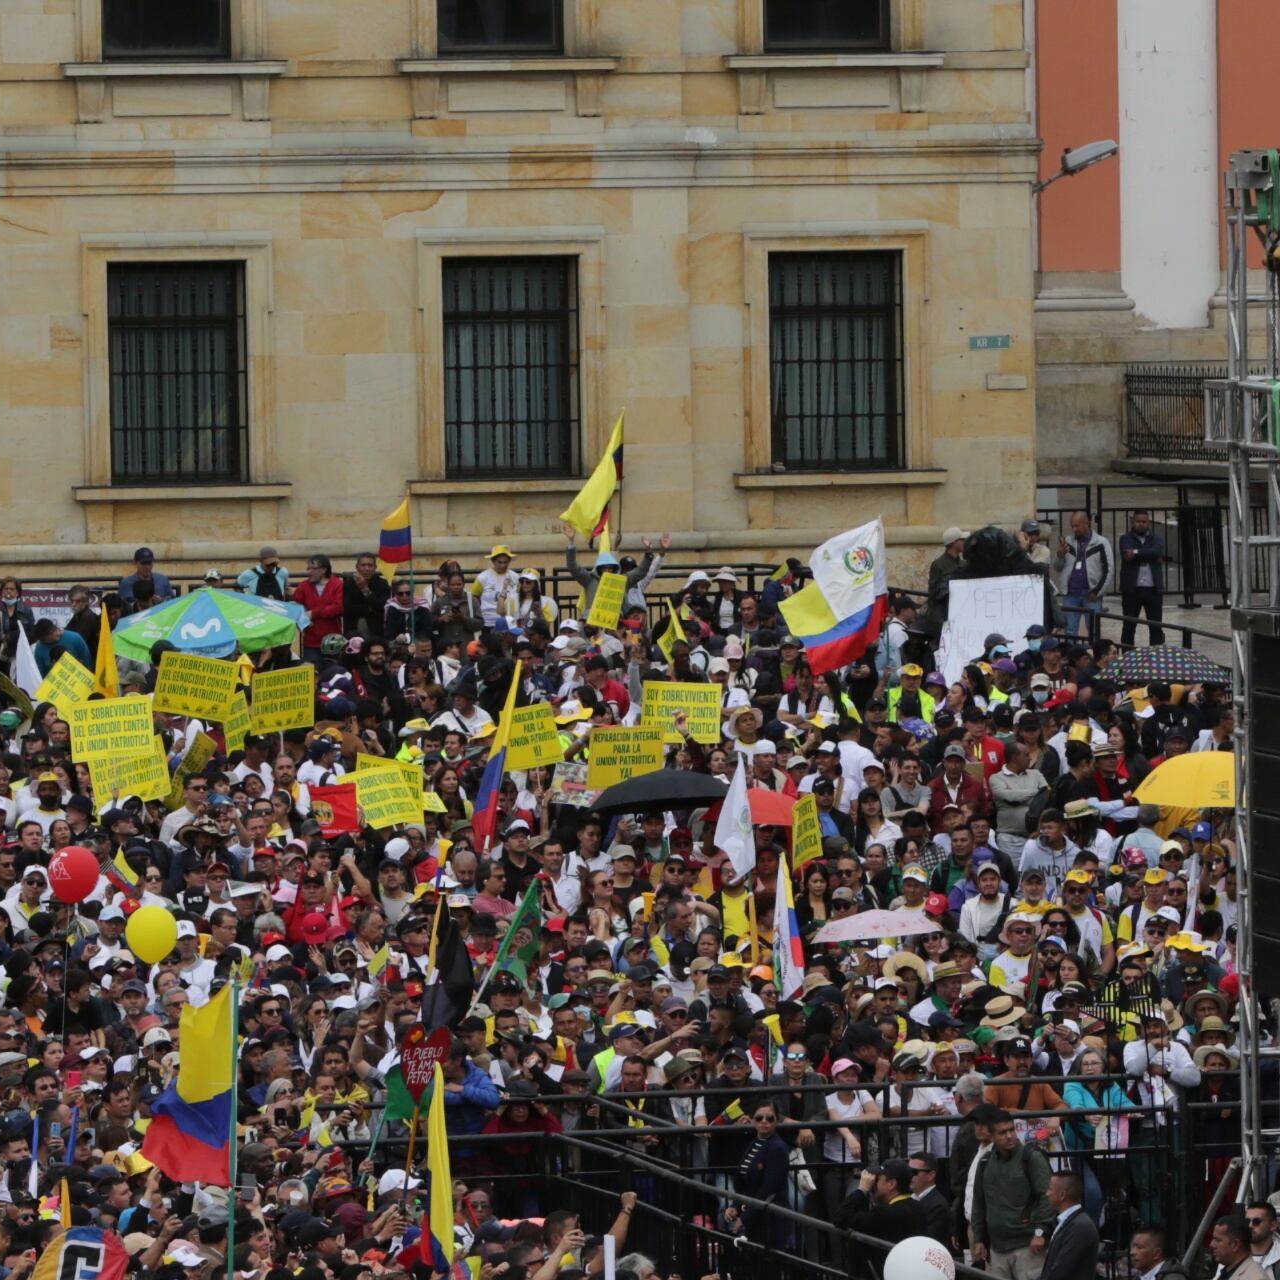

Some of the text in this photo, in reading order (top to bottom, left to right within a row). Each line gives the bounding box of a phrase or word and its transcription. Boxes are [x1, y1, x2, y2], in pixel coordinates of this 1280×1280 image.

[165, 653, 233, 676] SOY SOBREVIVIENTE
[158, 682, 167, 692] LA
[161, 670, 231, 690] DEL GENOCIDIO CONTRA
[646, 688, 718, 704] SOY SOBREVIVIENTE
[74, 702, 147, 722] SOY SOBREVIVIENTE
[643, 704, 655, 717] DEL
[74, 716, 149, 738] DEL GENOCIDIO CONTRA
[632, 730, 660, 741] INTEGRAL
[75, 741, 85, 753] LA
[613, 743, 641, 754] PARA LA
[403, 1046, 443, 1061] EL PUEBLO
[407, 1061, 417, 1071] TE
[407, 1070, 432, 1086] PETRO
